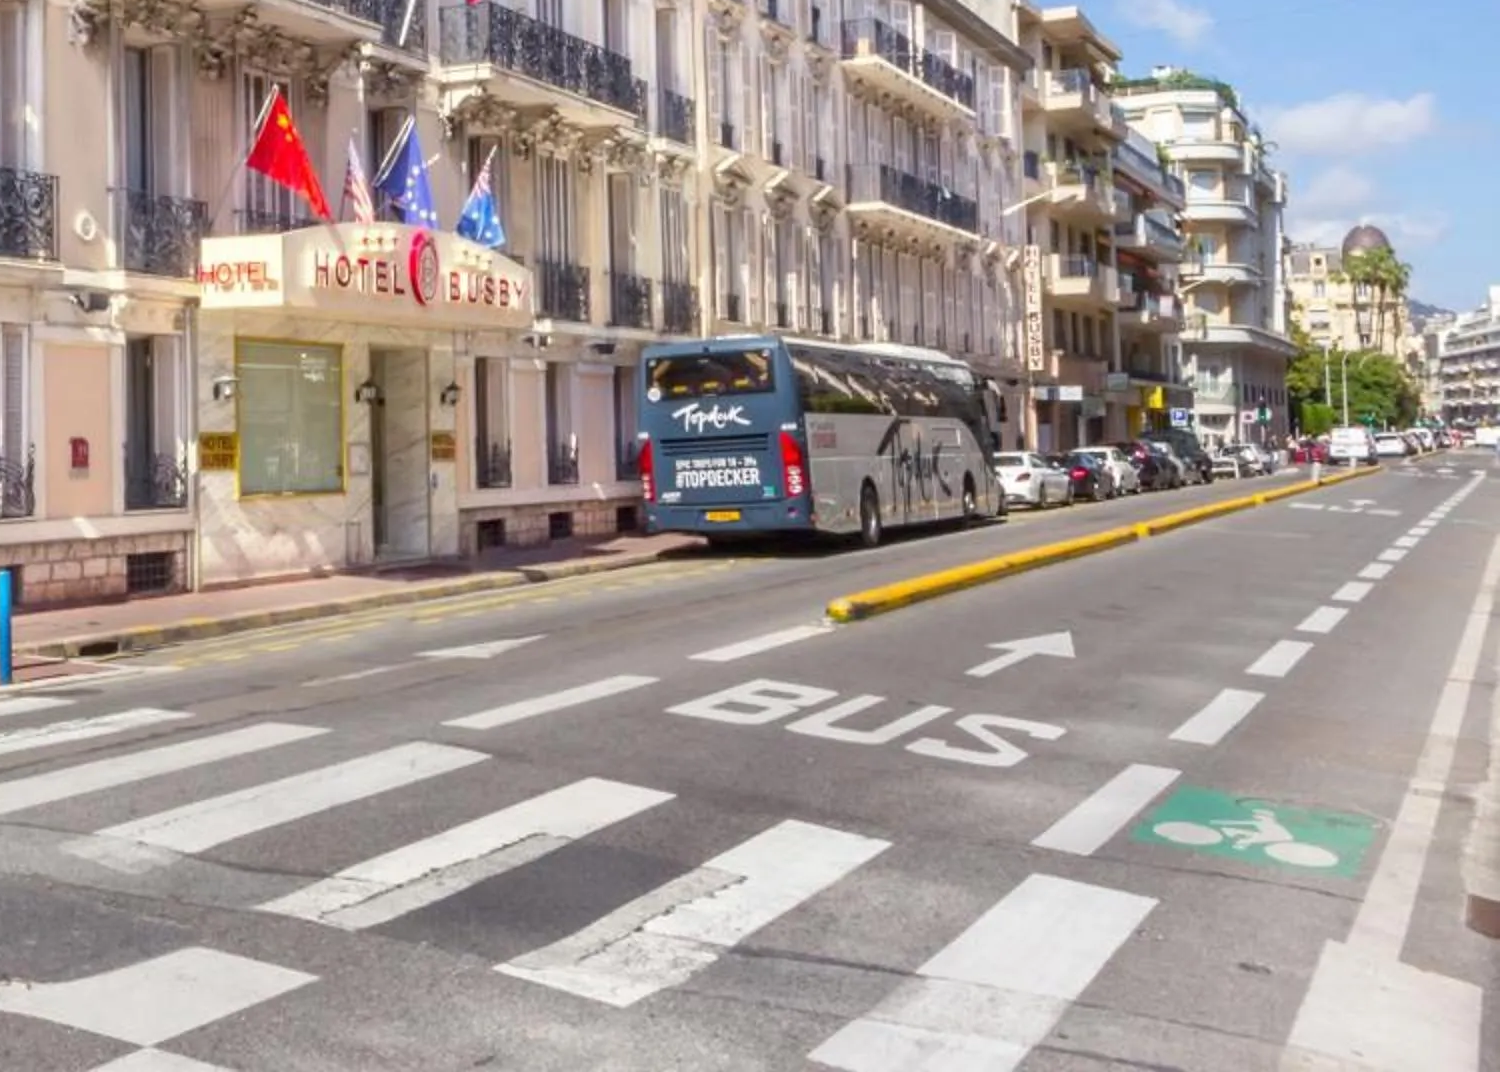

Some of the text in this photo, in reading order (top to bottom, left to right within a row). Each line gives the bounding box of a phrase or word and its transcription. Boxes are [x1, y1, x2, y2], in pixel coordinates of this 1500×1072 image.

[197, 261, 273, 284] HOTEL
[315, 248, 525, 307] HOTEL BUSBY
[675, 467, 761, 488] #TOPDECKER
[664, 678, 1068, 767] BUS
